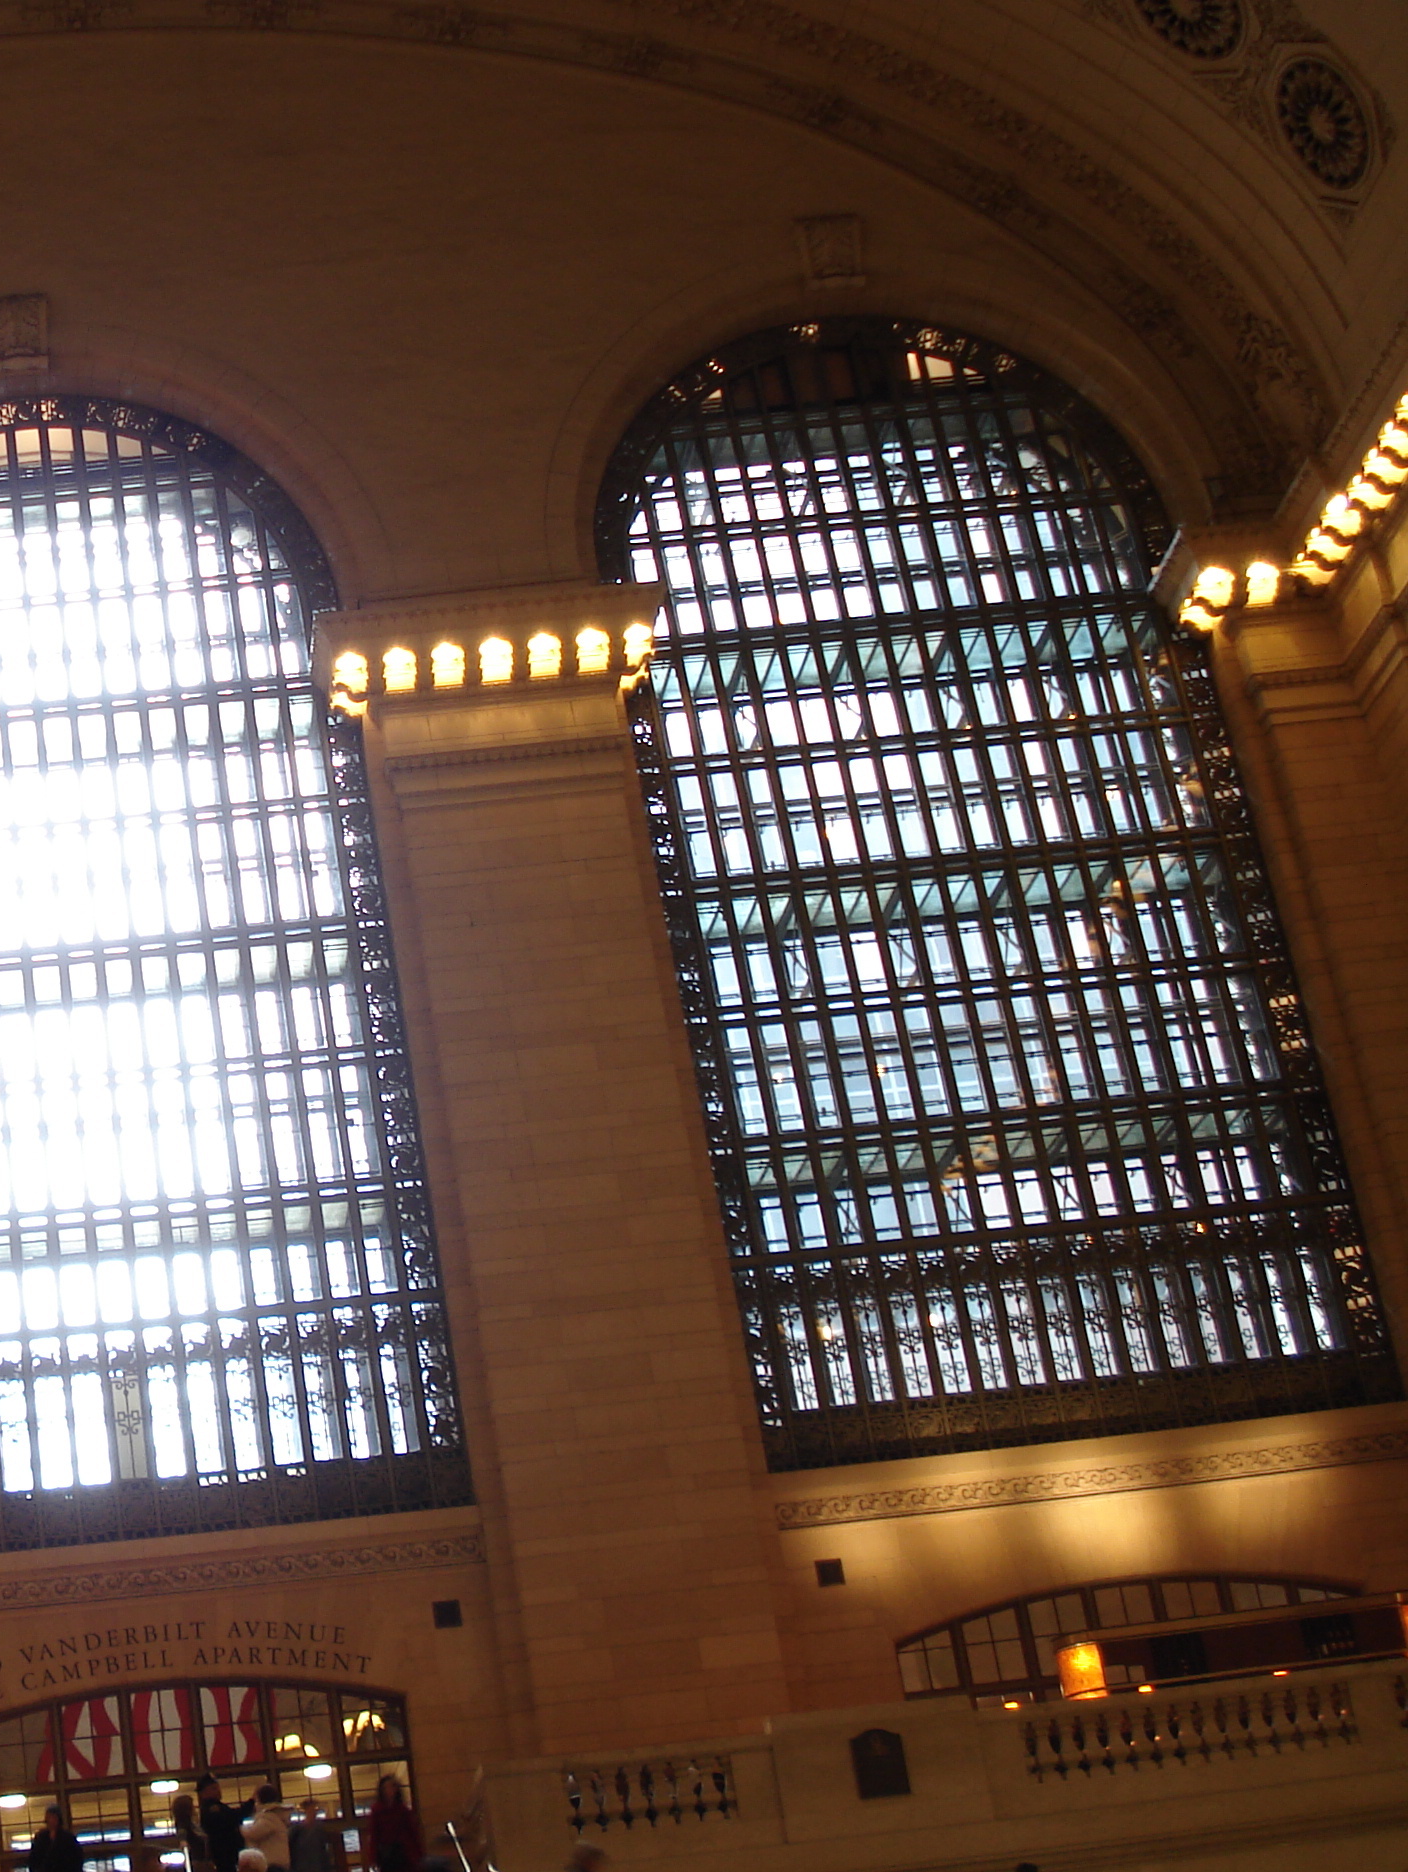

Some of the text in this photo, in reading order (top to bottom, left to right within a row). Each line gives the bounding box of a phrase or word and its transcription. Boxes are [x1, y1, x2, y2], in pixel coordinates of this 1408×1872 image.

[19, 1621, 206, 1665] VANDERBILT
[227, 1620, 346, 1645] AVENUE
[20, 1649, 175, 1692] CAMPBELL
[193, 1646, 372, 1675] APARTMENT
